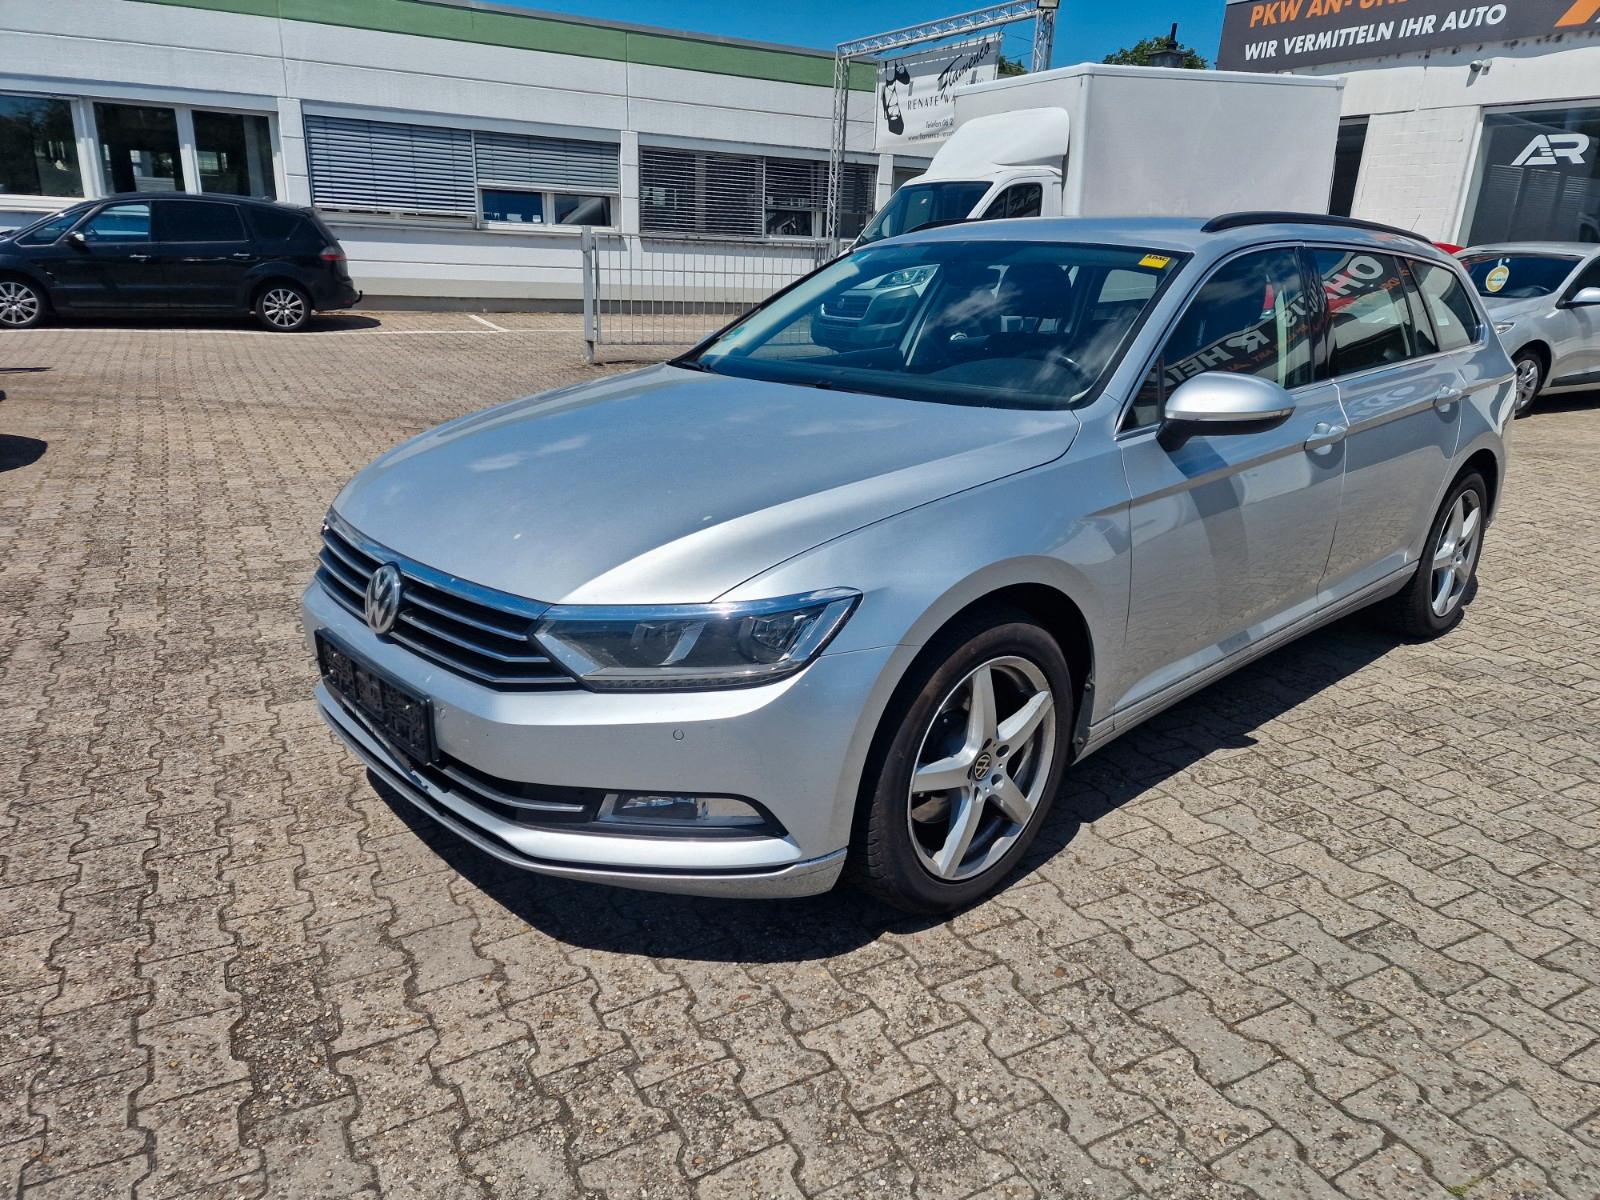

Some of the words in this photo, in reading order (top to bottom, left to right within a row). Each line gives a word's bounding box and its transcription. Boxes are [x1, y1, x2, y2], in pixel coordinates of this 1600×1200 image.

[1249, 0, 1302, 28] PKW
[1245, 40, 1278, 61] WIR
[1284, 21, 1395, 55] VERMITTELN
[1399, 14, 1437, 38] IHR
[1440, 4, 1507, 33] AUTO
[907, 95, 939, 111] RENATE
